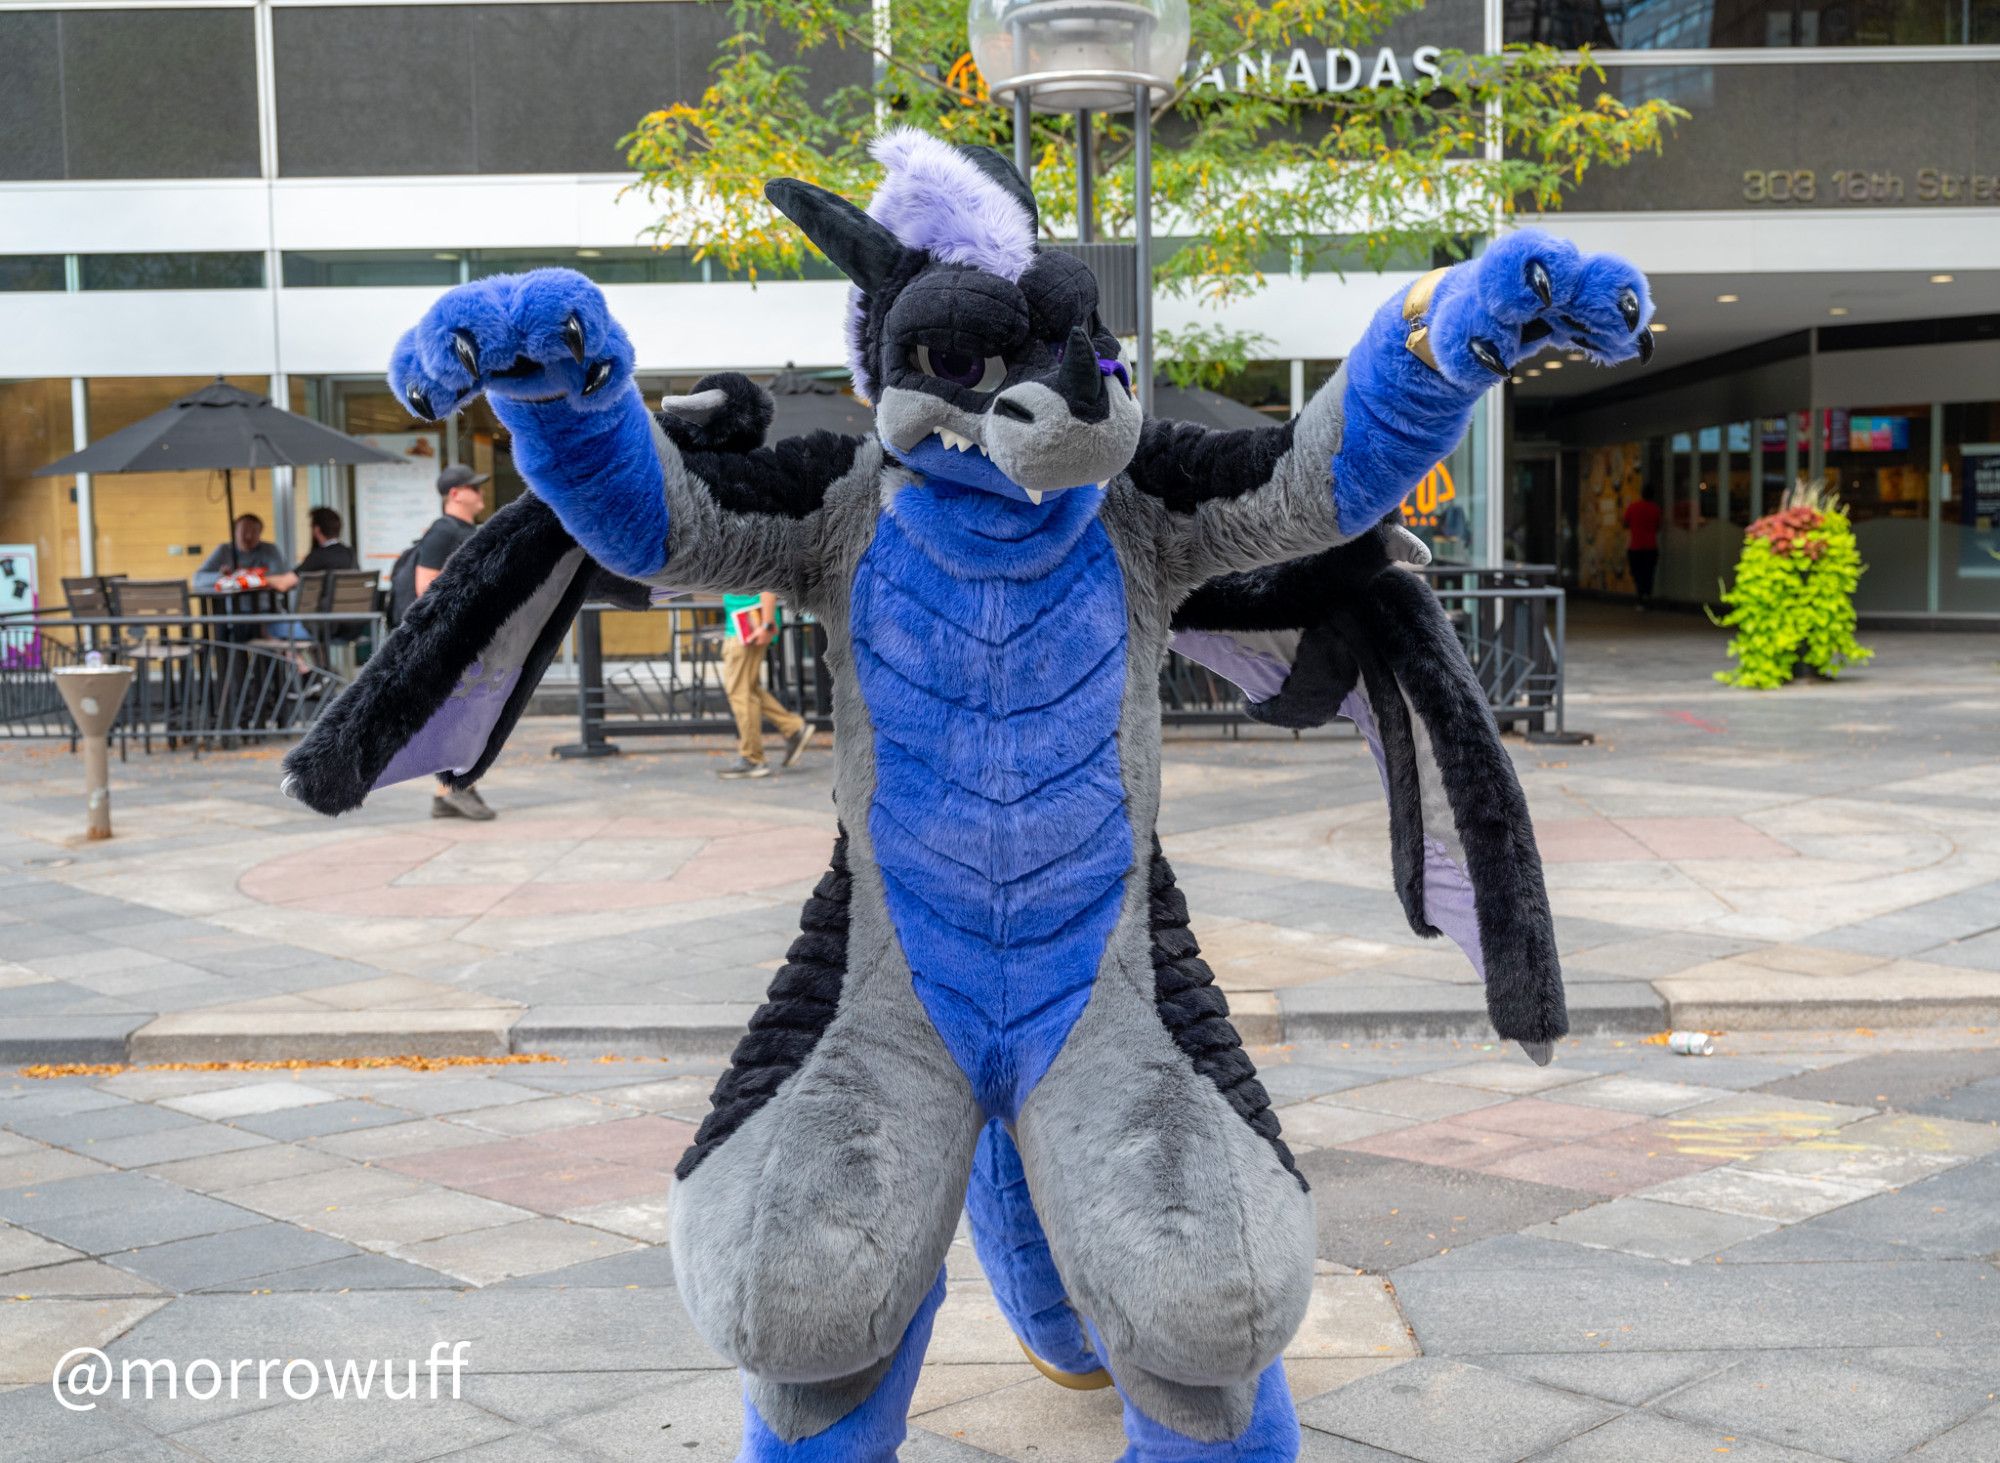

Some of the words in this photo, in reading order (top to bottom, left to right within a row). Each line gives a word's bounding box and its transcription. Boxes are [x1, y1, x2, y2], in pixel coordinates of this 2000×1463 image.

[1180, 46, 1442, 93] ANADAS
[1743, 169, 1816, 201] 303
[1832, 168, 1904, 201] 16th
